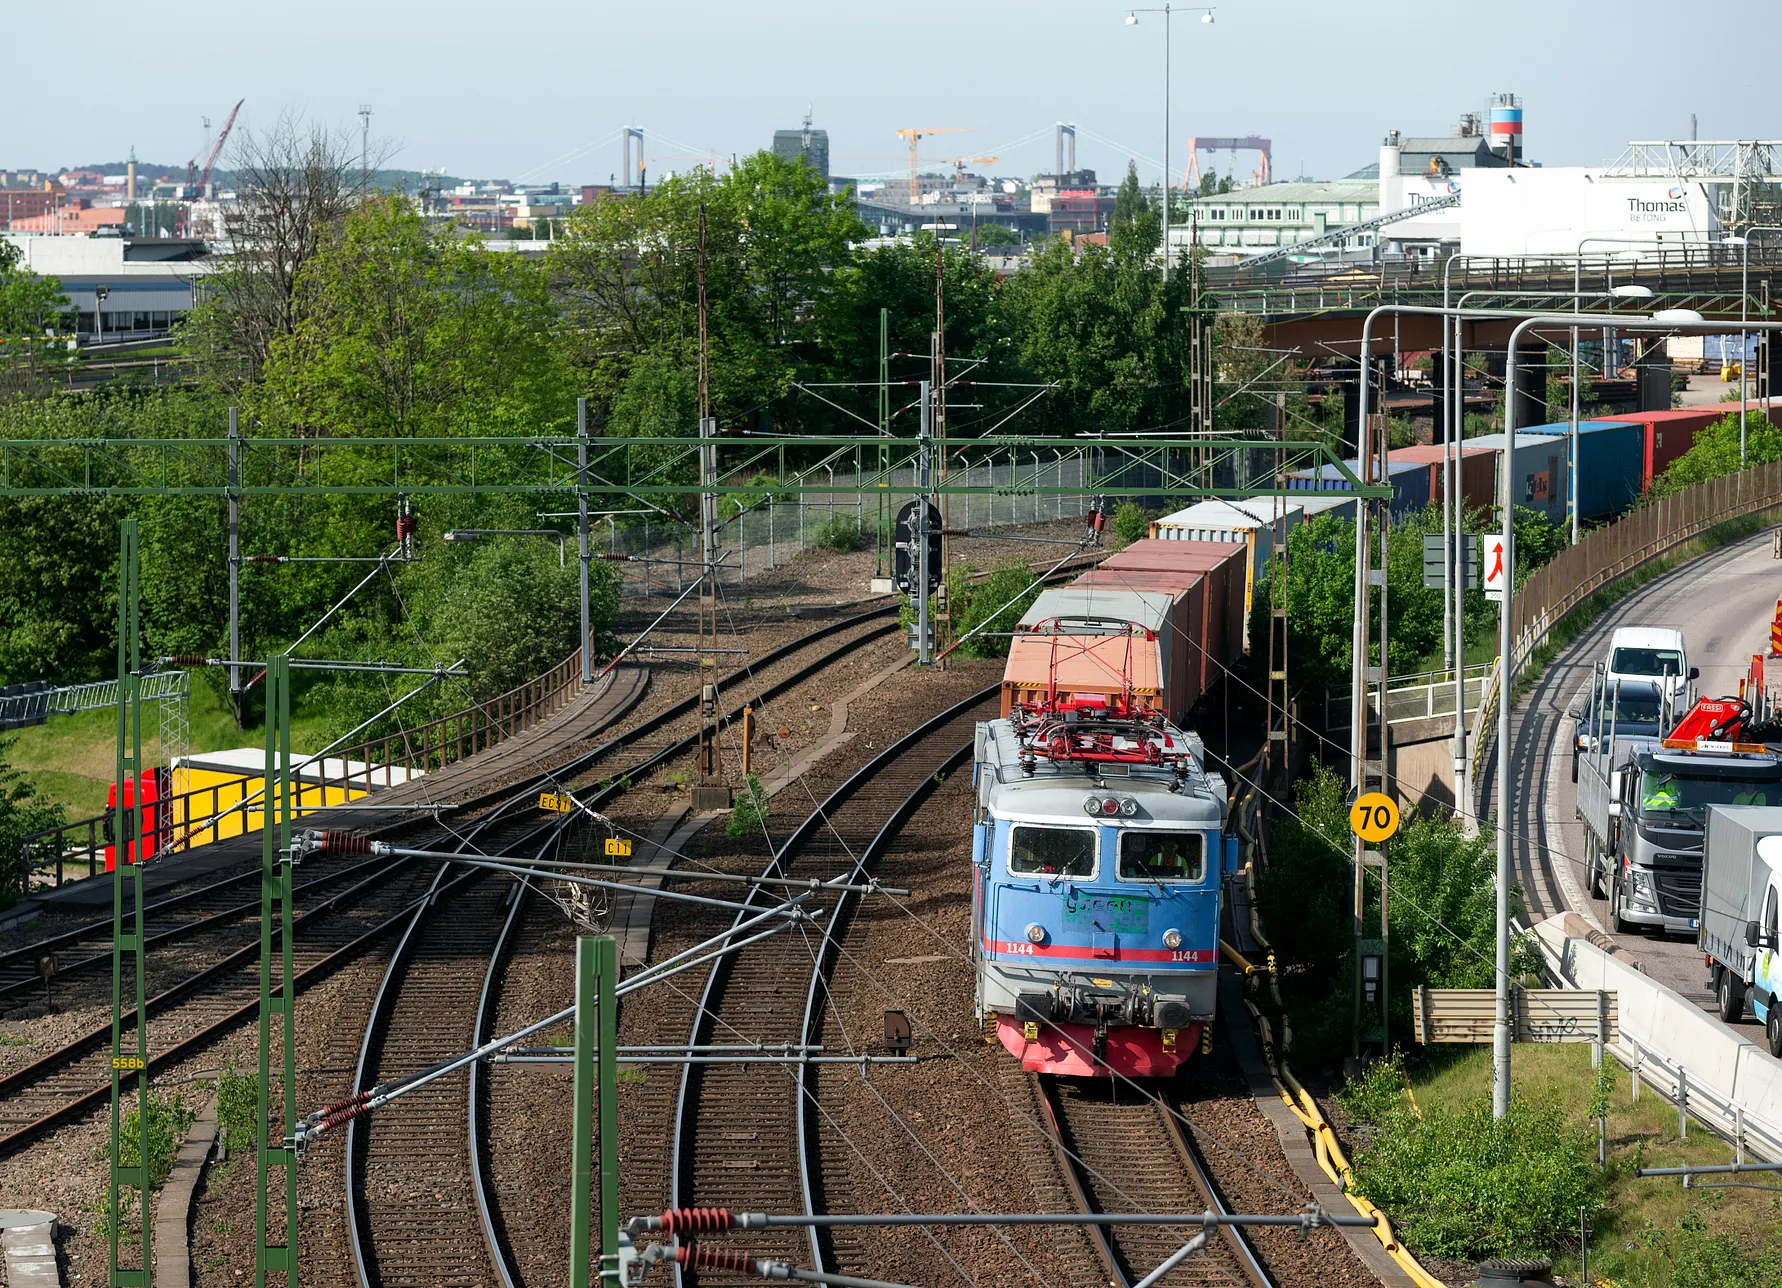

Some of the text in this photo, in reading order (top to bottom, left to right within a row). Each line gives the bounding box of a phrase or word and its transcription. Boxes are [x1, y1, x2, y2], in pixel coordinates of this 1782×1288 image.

[1627, 198, 1686, 212] Thomas
[1630, 213, 1666, 222] BETONG
[1359, 805, 1391, 830] 70
[608, 842, 628, 855] C11
[1006, 943, 1034, 955] 1144
[1171, 950, 1199, 962] 1144
[112, 1057, 145, 1069] 558b
